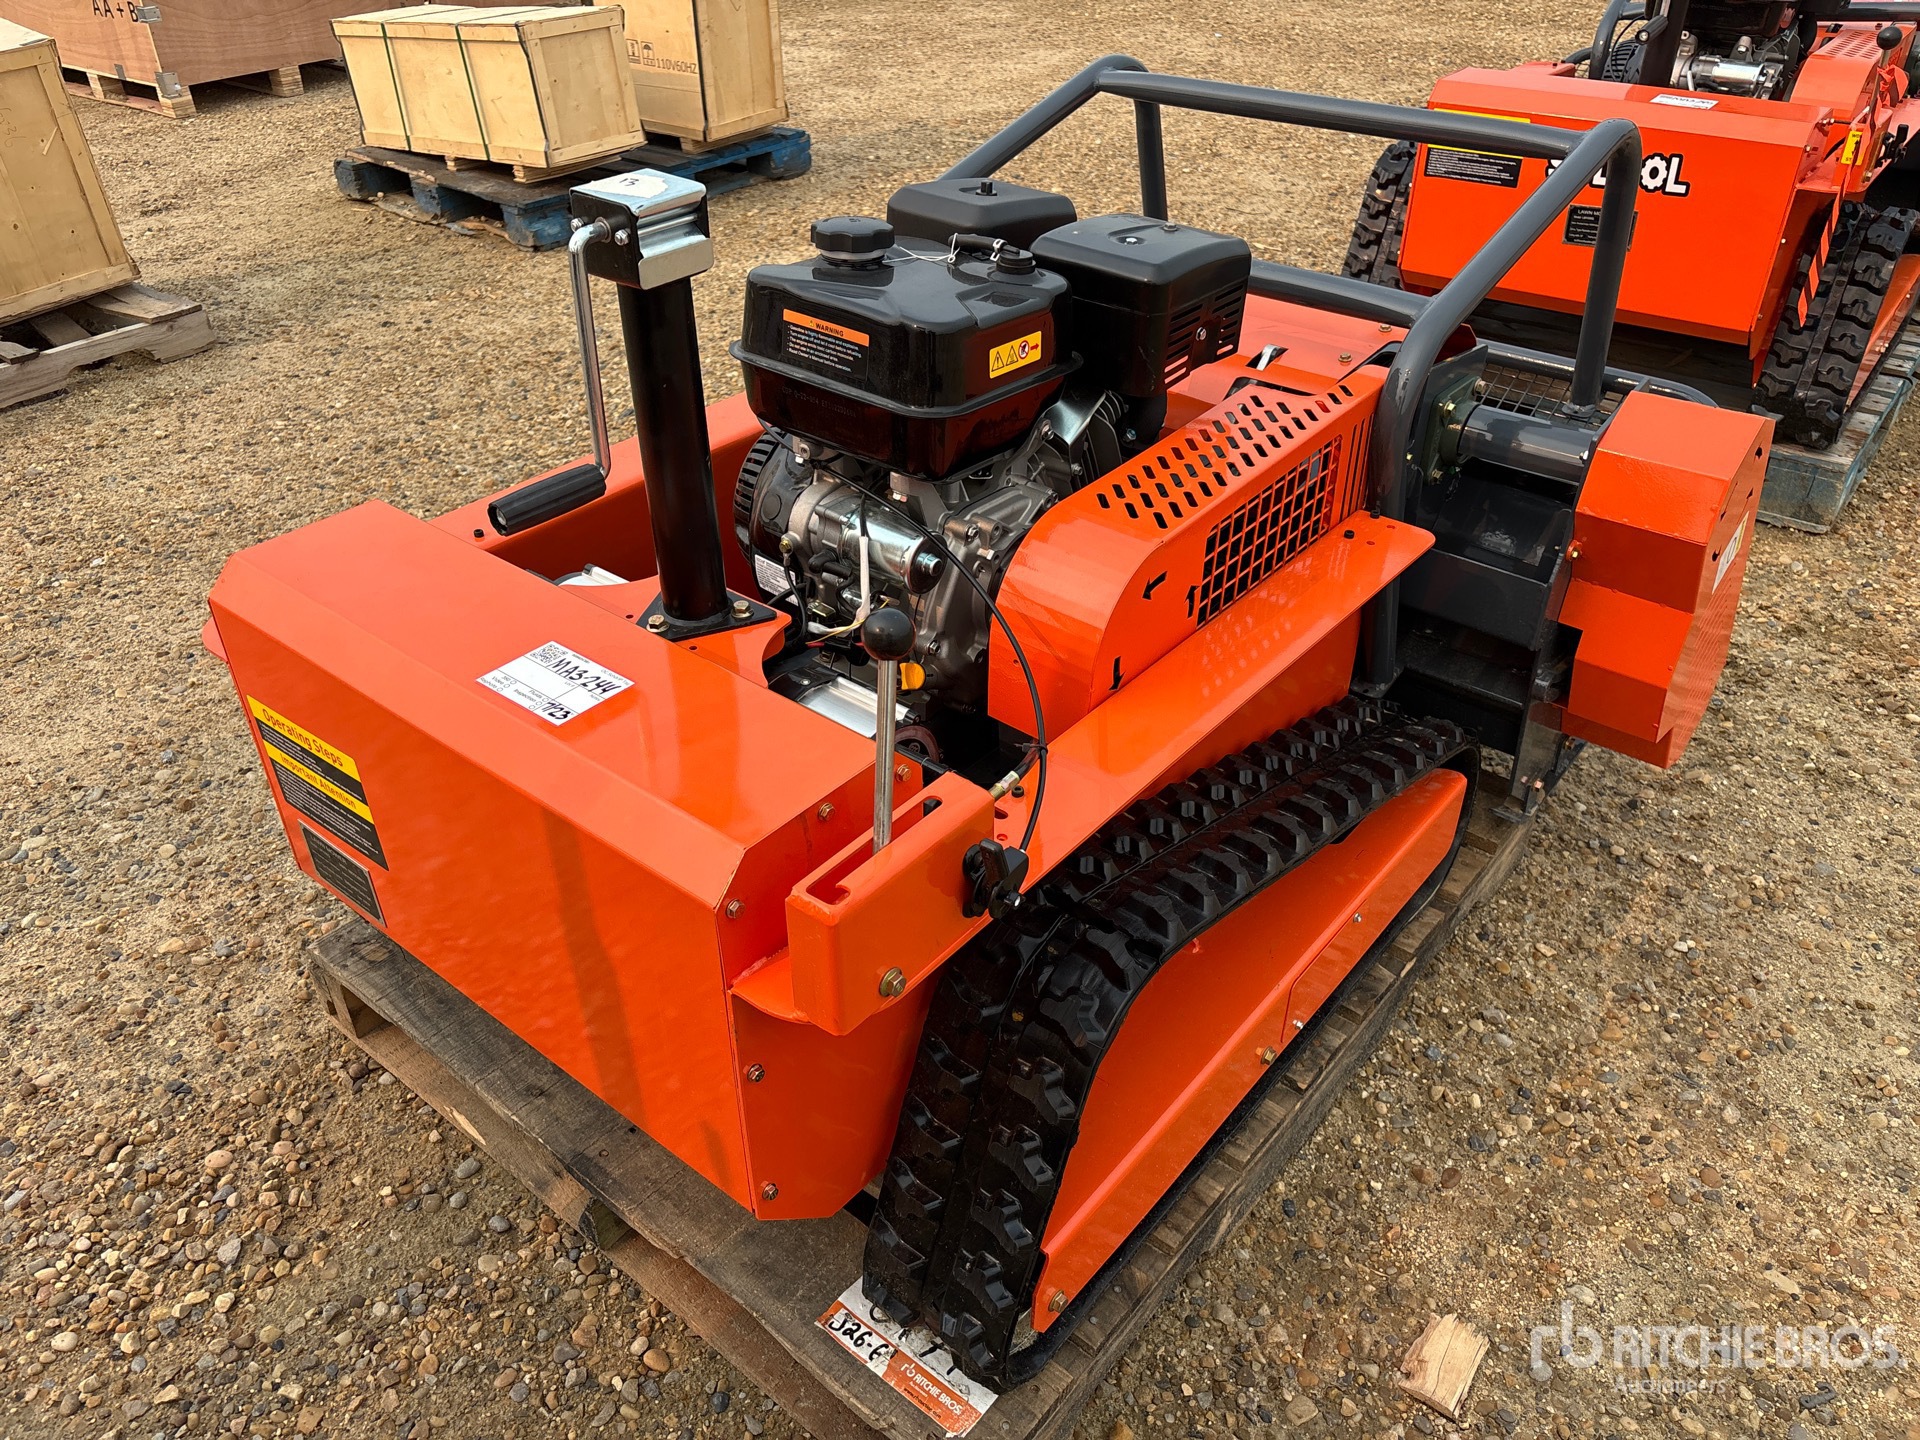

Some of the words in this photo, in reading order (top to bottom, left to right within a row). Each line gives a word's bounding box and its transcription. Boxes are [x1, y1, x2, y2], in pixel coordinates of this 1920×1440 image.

[656, 57, 698, 74] 110V60HZ
[815, 322, 843, 336] WARNING
[262, 708, 312, 751] Operating
[313, 740, 344, 768] Steps
[280, 753, 318, 785] Important
[319, 778, 357, 809] Attention
[913, 1373, 942, 1398] RITCHIE
